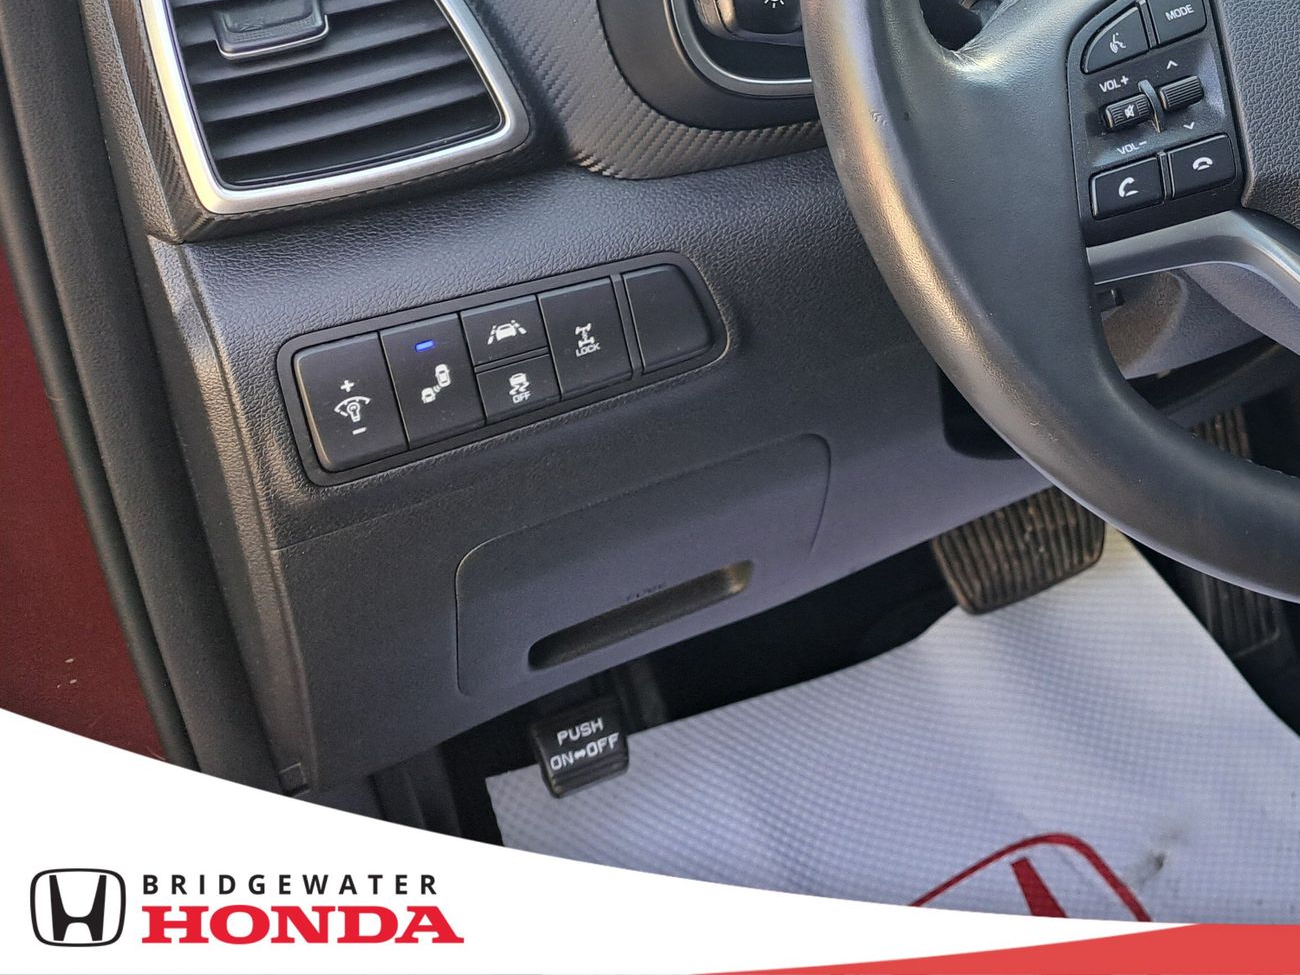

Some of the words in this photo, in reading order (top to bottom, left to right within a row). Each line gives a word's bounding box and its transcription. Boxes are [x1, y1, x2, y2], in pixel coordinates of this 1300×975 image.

[1165, 3, 1194, 21] MODE
[575, 342, 601, 358] LOCK
[512, 390, 531, 404] OFF
[556, 717, 604, 746] PUSH
